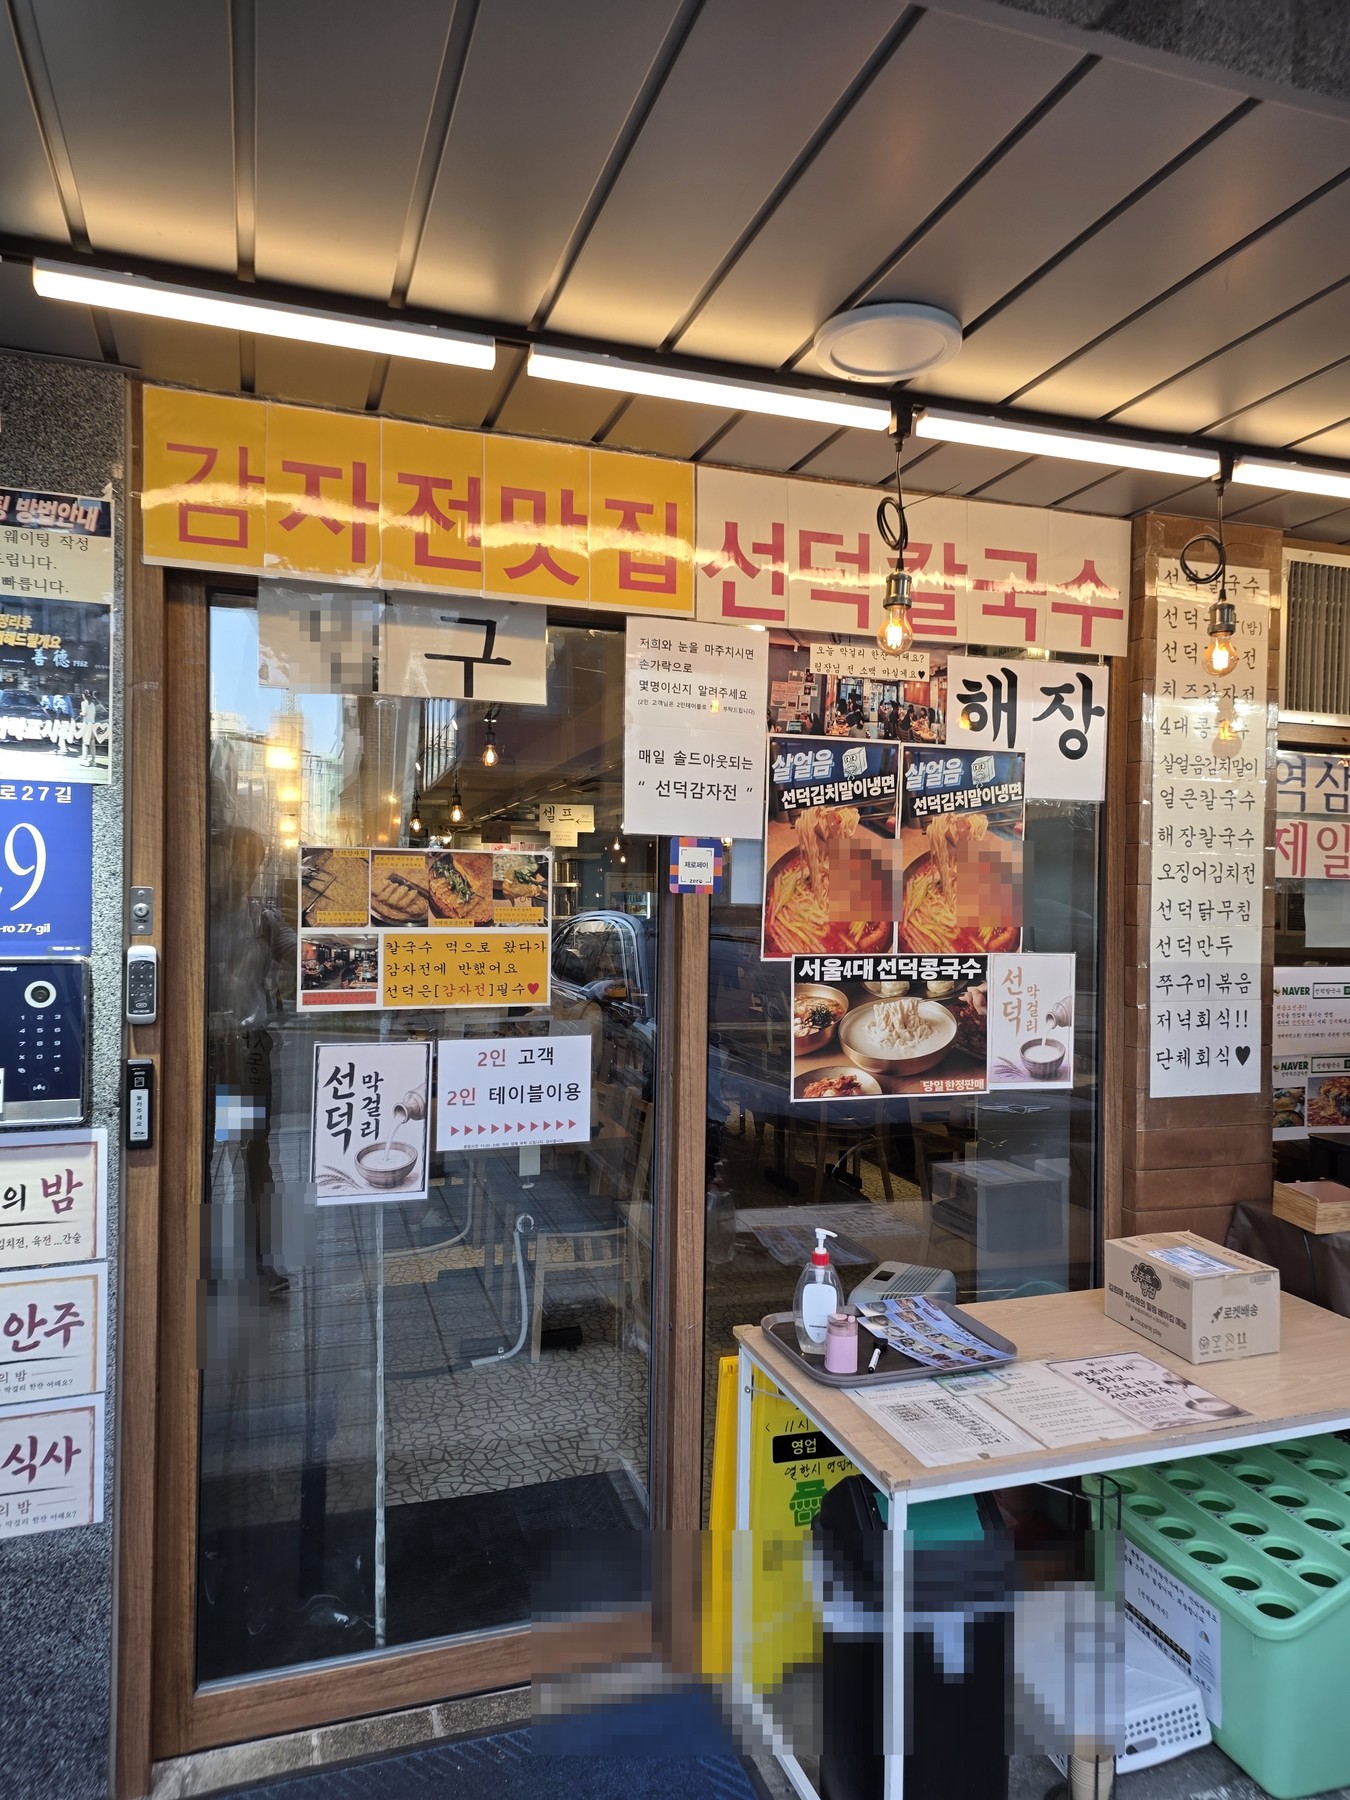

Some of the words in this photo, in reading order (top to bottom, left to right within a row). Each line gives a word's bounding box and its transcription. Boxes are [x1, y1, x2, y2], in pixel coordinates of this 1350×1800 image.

[16, 497, 100, 533] 방법안내
[4, 529, 50, 548] 웨이팅
[59, 535, 89, 552] 작성
[2, 575, 69, 595] 빠릅니다.
[702, 520, 1124, 648] 선덕칼국수
[1162, 606, 1263, 637] 선덕(밥)
[639, 637, 672, 651] 저희와
[678, 640, 699, 654] 눈을
[704, 643, 754, 660] 마주치시면
[816, 646, 835, 656] 오늘
[839, 647, 865, 658] 막걸리
[871, 649, 887, 660] 한잔
[1162, 640, 1257, 671] 선덕전
[638, 659, 693, 674] 손가락으로
[847, 664, 855, 675] 전
[861, 666, 876, 677] 소맥
[882, 667, 917, 679] 마실게요
[639, 679, 692, 696] 몇명이신지
[697, 684, 748, 700] 알려주세요
[1162, 678, 1256, 707] 치즈감자전
[638, 749, 665, 765] 매일
[673, 750, 753, 770] 솔드아웃되는
[771, 748, 836, 784] 살얼음
[1159, 753, 1259, 778] 살얼음김치말이
[904, 757, 965, 792] 살얼음
[655, 780, 738, 802] 선덕감자전
[781, 774, 896, 810] 선덕김치말이냉면
[913, 781, 1023, 816] 선덕김치말이냉면
[1159, 786, 1256, 812] 얼큰칼국수
[542, 805, 574, 824] 셀프
[1157, 824, 1255, 849] 해장칼국수
[684, 861, 709, 869] 제로페이
[1156, 860, 1256, 885] 오징어김치전
[1156, 898, 1251, 922] 선덕닭무침
[385, 940, 433, 955] 칼국수
[445, 941, 491, 955] 먹으로
[502, 940, 547, 955] 왔다가
[1155, 934, 1234, 958] 선덕만두
[385, 962, 447, 976] 감자전에
[457, 962, 519, 976] 반했어요
[799, 958, 874, 982] 서울4대
[876, 957, 982, 981] 선덕콩국수
[1155, 972, 1252, 997] 쭈구미볶음
[1281, 986, 1311, 996] NAVER
[1001, 966, 1024, 1037] 선덕
[1025, 983, 1041, 1034] 막걸리
[1156, 1008, 1249, 1033] 저녁회식!!
[477, 1048, 507, 1068] 2인
[517, 1046, 555, 1066] 고객
[1155, 1045, 1231, 1070] 단체회식
[1280, 1061, 1309, 1071] NAVER
[446, 1087, 477, 1107] 2인
[488, 1083, 582, 1105] 테이블이용
[922, 1079, 944, 1092] 당일
[945, 1079, 985, 1091] 한정판매
[322, 1062, 356, 1156] 선덕
[360, 1071, 384, 1141] 막걸리
[40, 1168, 84, 1215] 밤
[32, 1233, 52, 1248] 육전
[1223, 1303, 1259, 1320] 로켓배송
[3, 1302, 85, 1353] 안주
[15, 1369, 28, 1383] 밤
[29, 1382, 44, 1391] 한잔
[46, 1378, 74, 1389] 어때요?
[791, 1437, 817, 1455] 영업
[0, 1435, 82, 1485] 식사
[784, 1461, 821, 1481] 열한시
[18, 1499, 32, 1515] 밤
[32, 1515, 48, 1525] 한잔
[50, 1510, 77, 1522] 어때요?
